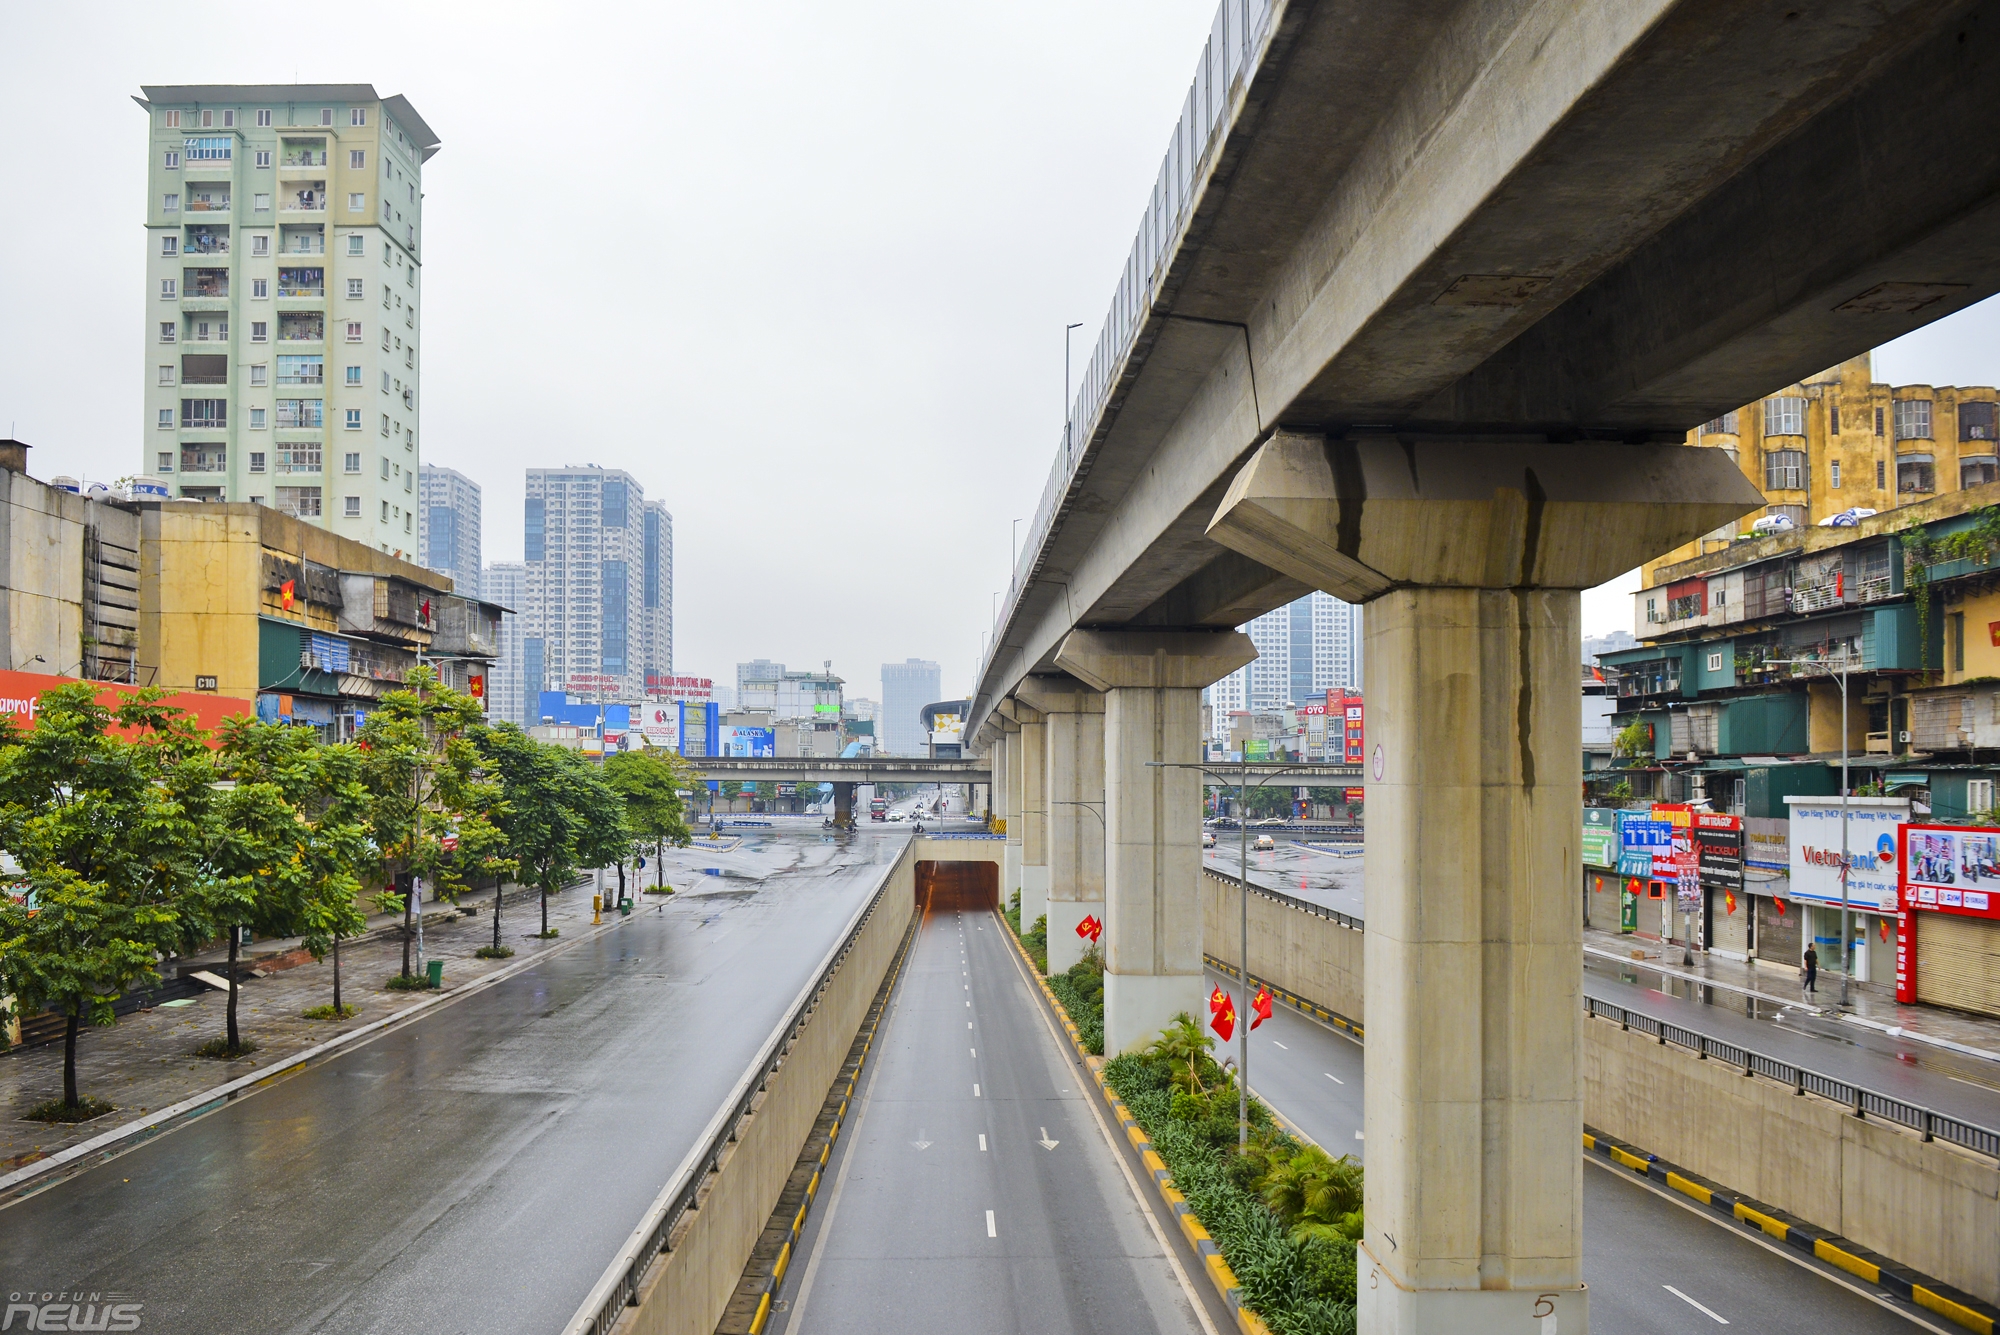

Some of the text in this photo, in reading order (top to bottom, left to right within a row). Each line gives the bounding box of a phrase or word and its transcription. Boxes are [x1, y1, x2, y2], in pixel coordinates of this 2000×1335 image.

[197, 677, 216, 690] C10
[1307, 706, 1324, 714] OYO
[1825, 809, 1839, 818] TMCP
[1841, 811, 1854, 821] Cng
[1889, 812, 1903, 821] Nam
[1705, 845, 1739, 855] CLICKBUY
[1947, 894, 1961, 902] SYM
[1370, 1268, 1379, 1290] 5
[1532, 1293, 1560, 1319] 5
